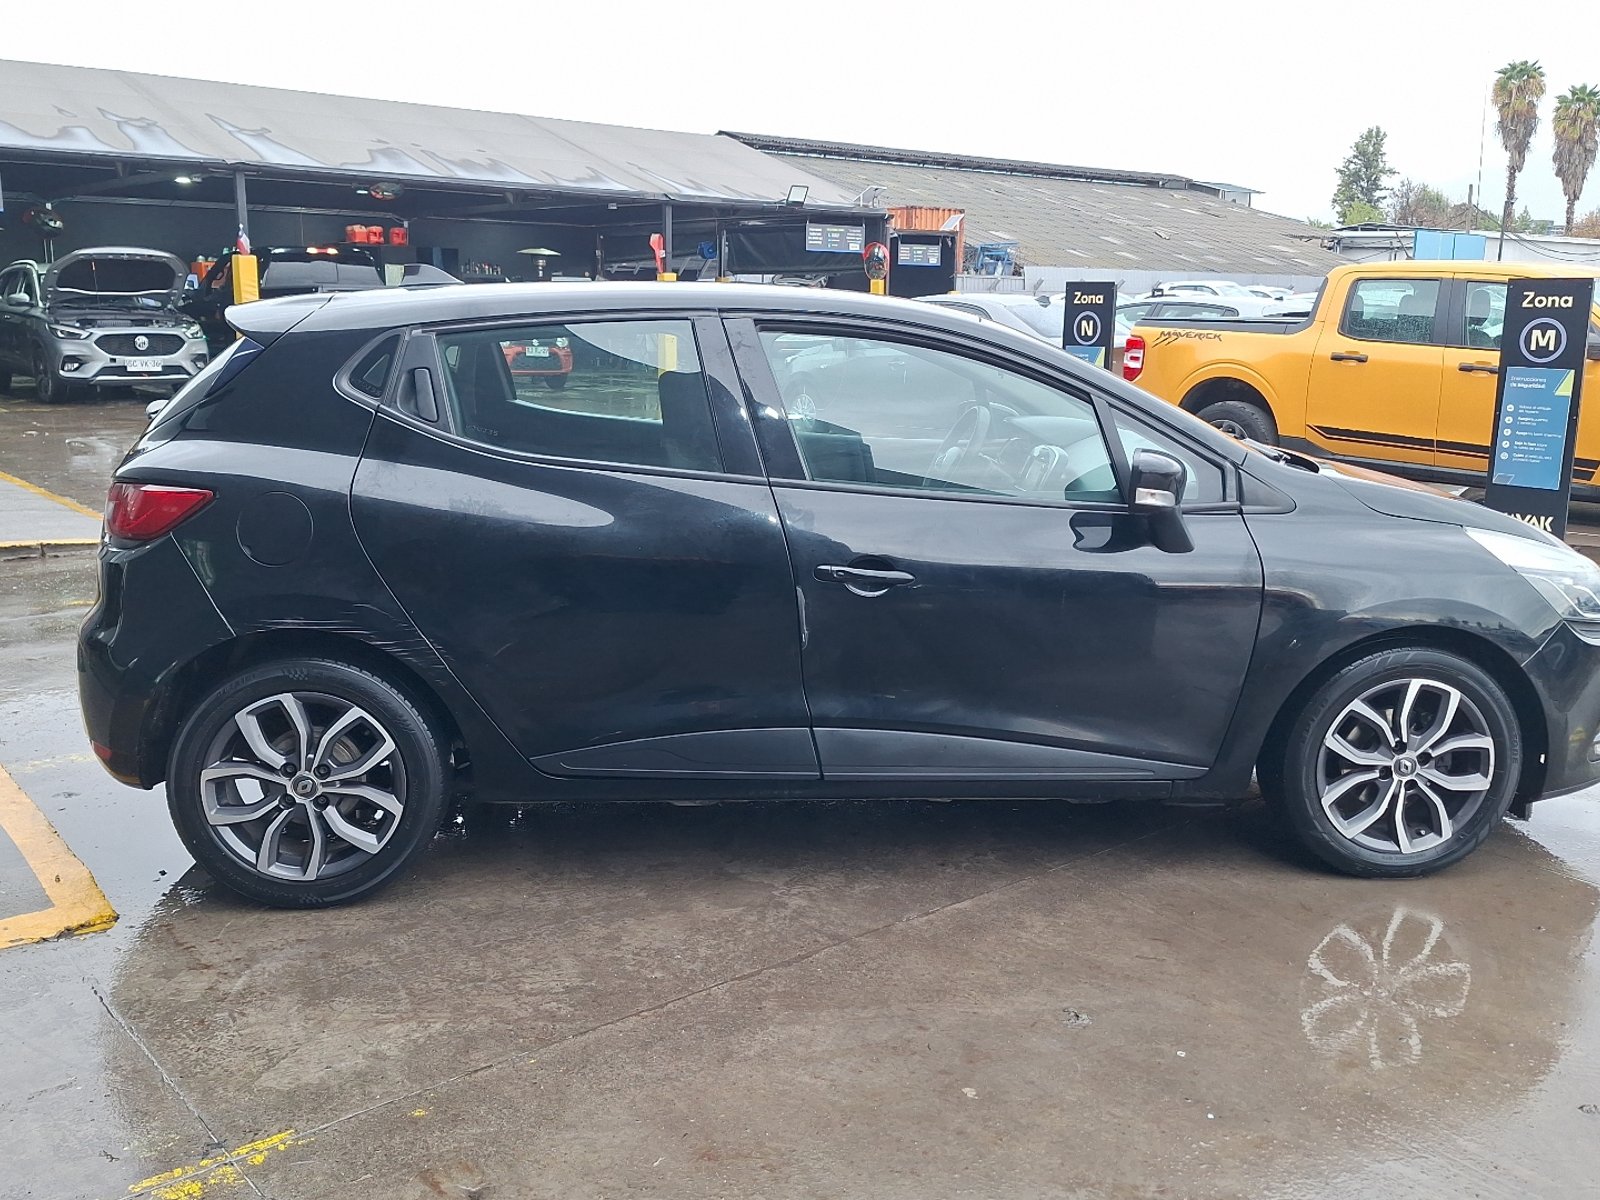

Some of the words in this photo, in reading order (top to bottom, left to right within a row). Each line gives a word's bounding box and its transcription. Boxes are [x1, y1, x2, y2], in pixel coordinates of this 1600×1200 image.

[1073, 291, 1104, 304] Zona
[1522, 291, 1574, 308] Zona
[1080, 320, 1094, 337] N
[1157, 330, 1223, 342] MAVERICK
[1529, 329, 1557, 351] M
